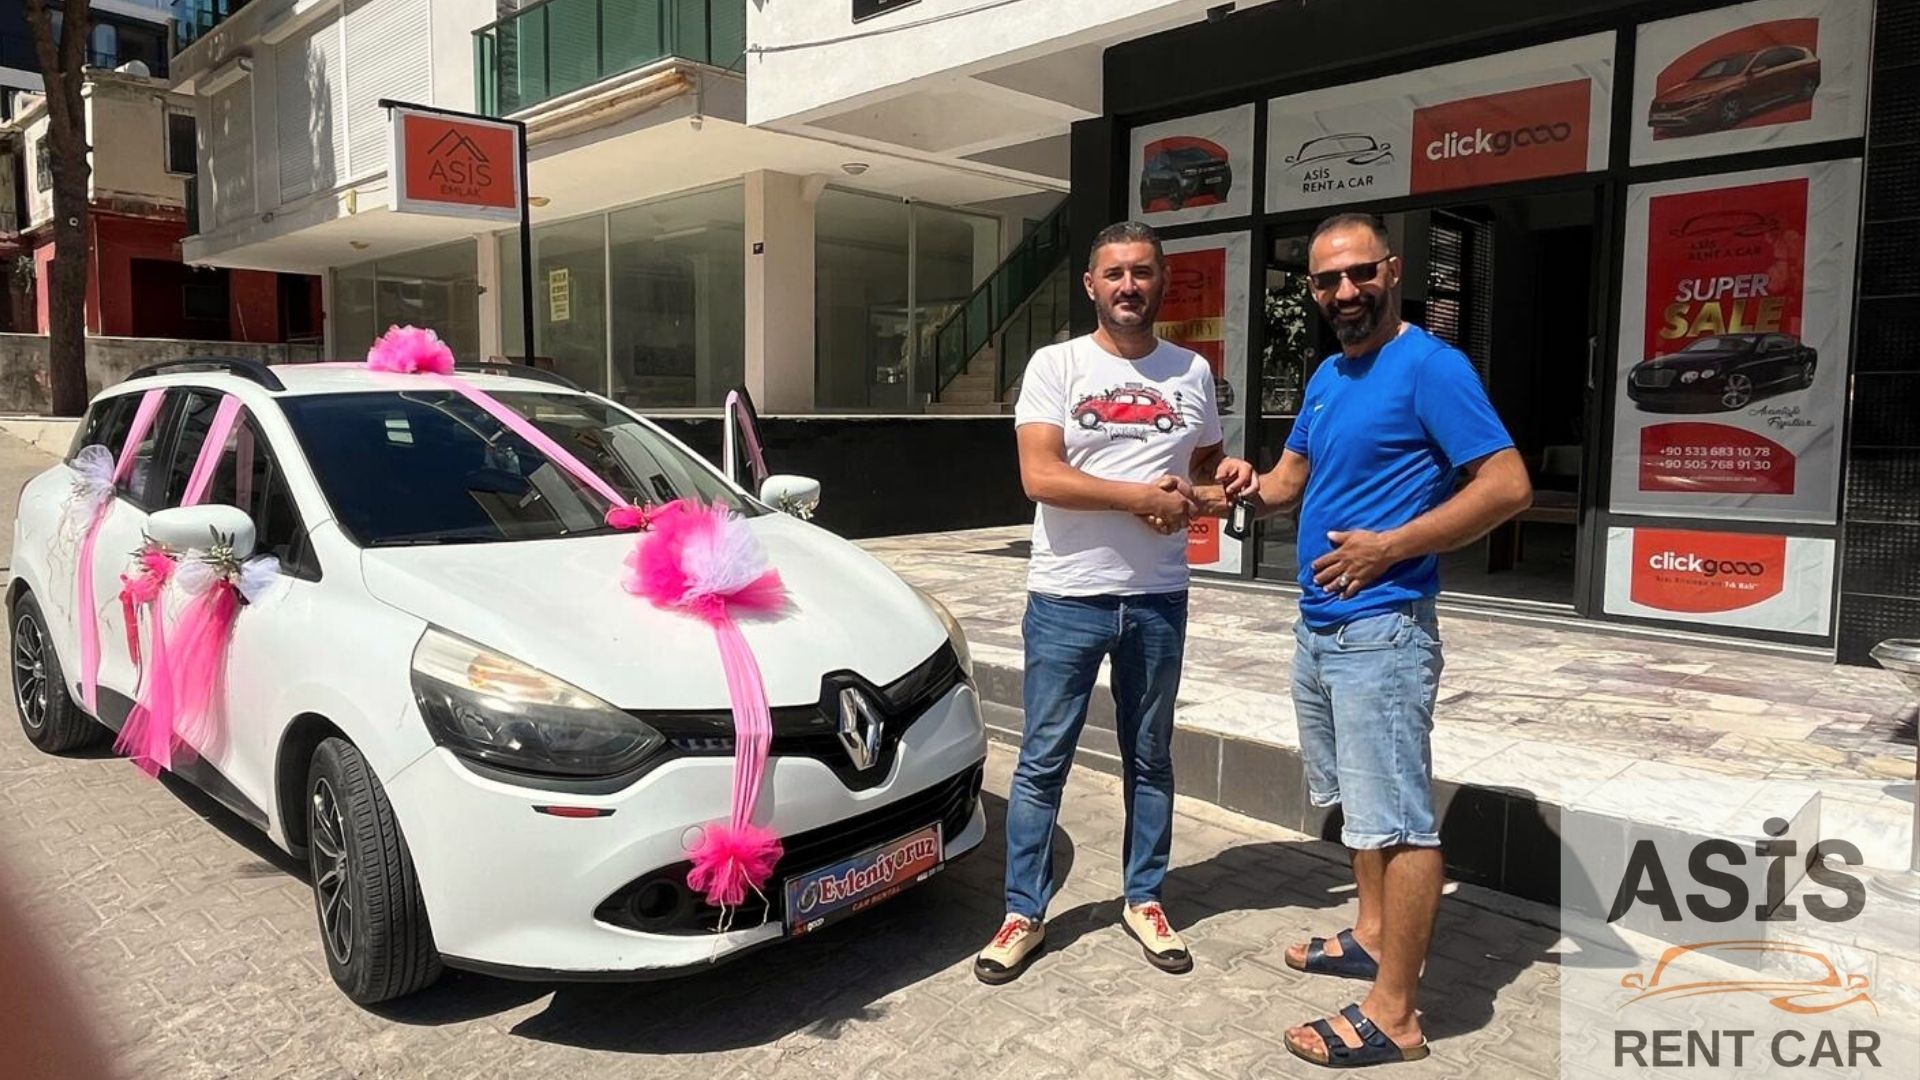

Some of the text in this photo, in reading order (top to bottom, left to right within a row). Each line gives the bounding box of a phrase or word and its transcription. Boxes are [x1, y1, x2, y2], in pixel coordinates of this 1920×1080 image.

[428, 156, 492, 187] ASİS
[1304, 167, 1330, 180] ASİS
[1303, 175, 1374, 193] RENT A CAR
[1676, 273, 1770, 302] SUPER
[1659, 296, 1785, 339] SALE
[1159, 319, 1214, 340] UXURY
[1684, 446, 1707, 456] 533
[1710, 446, 1734, 457] 683
[1737, 447, 1751, 457] 10
[1754, 447, 1771, 457] 78
[1684, 460, 1707, 469] 505
[1710, 460, 1734, 470] 768
[1737, 460, 1751, 470] 91
[1754, 460, 1771, 470] 30
[820, 837, 935, 904] Evleniyoruz
